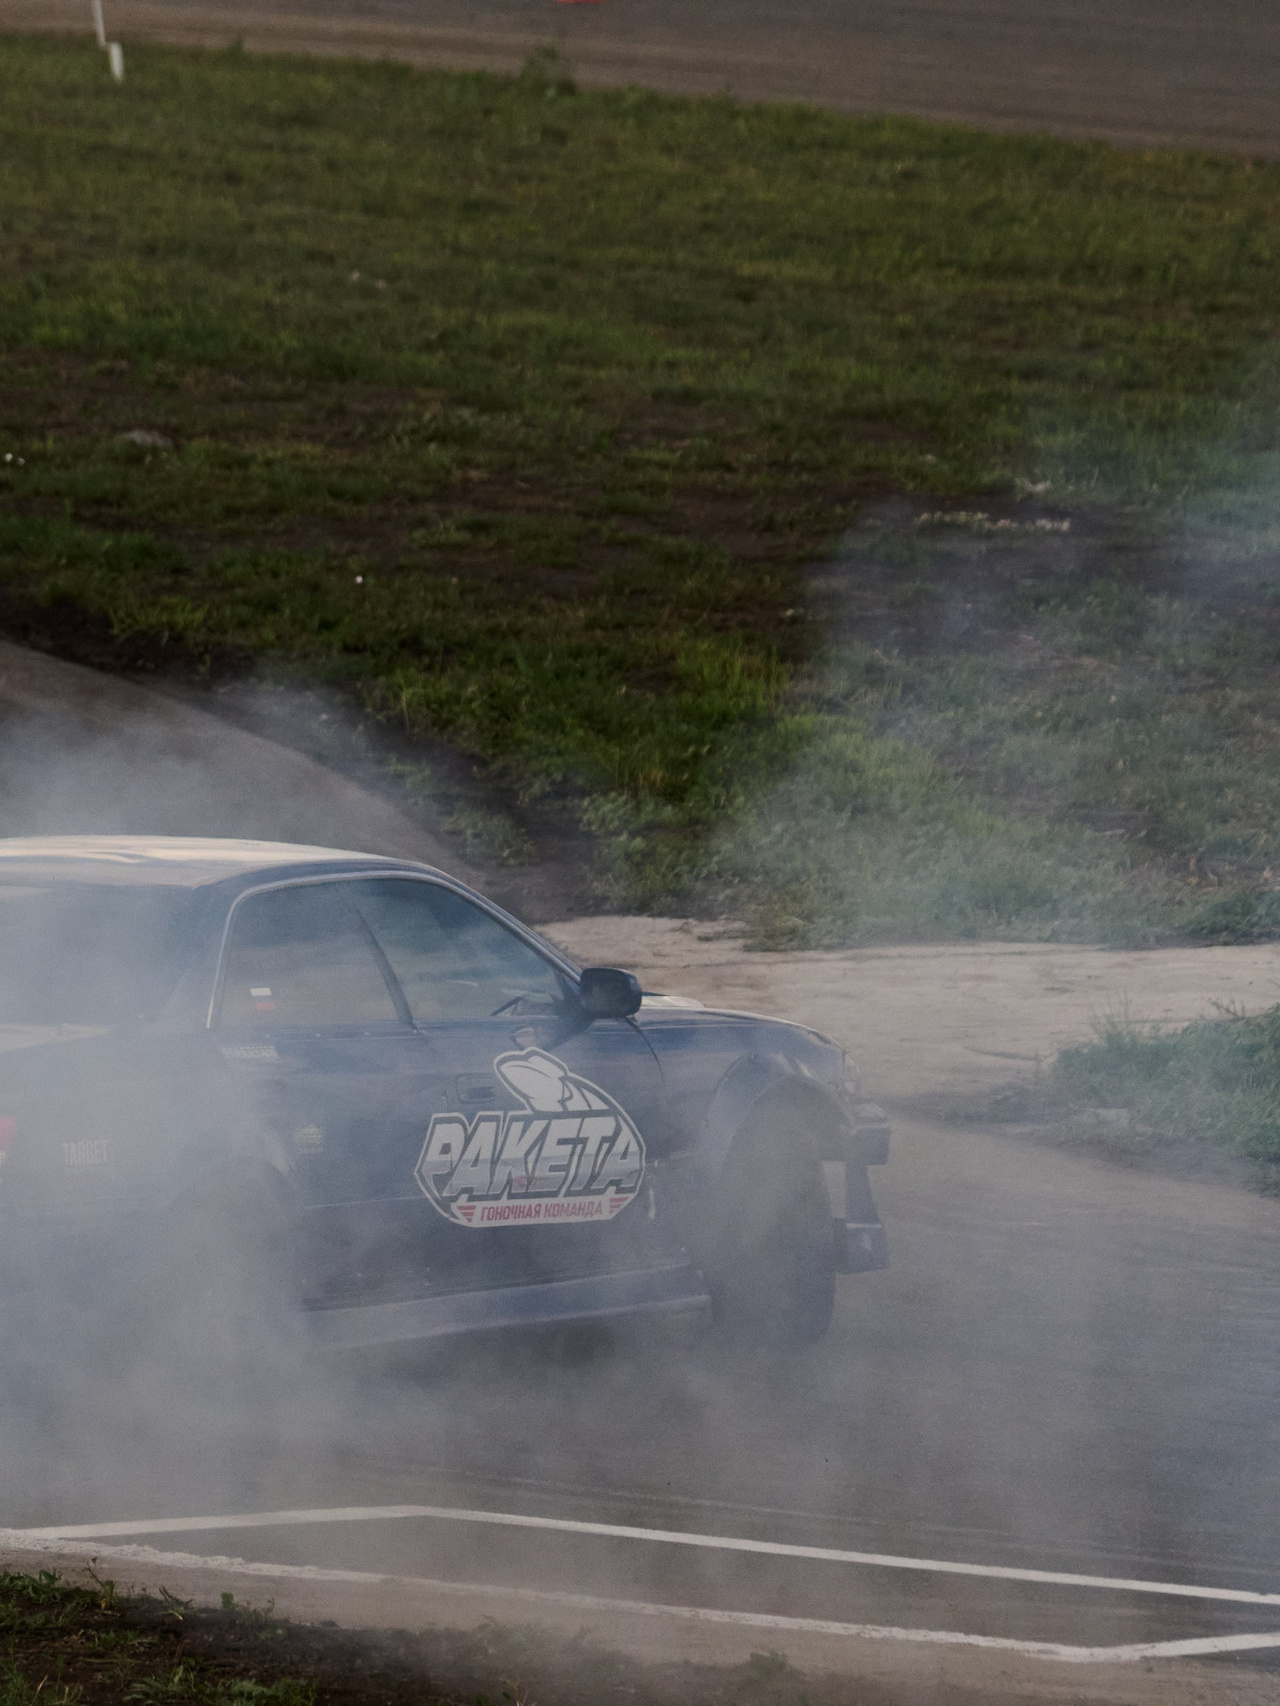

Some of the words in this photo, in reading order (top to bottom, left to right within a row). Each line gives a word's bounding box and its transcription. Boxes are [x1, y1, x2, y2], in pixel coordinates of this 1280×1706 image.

[61, 1139, 108, 1165] TARGET
[421, 1115, 641, 1197] РАКЕТА
[480, 1202, 541, 1222] ГОНОЧНАЯ
[544, 1201, 603, 1218] КОМАНДА
